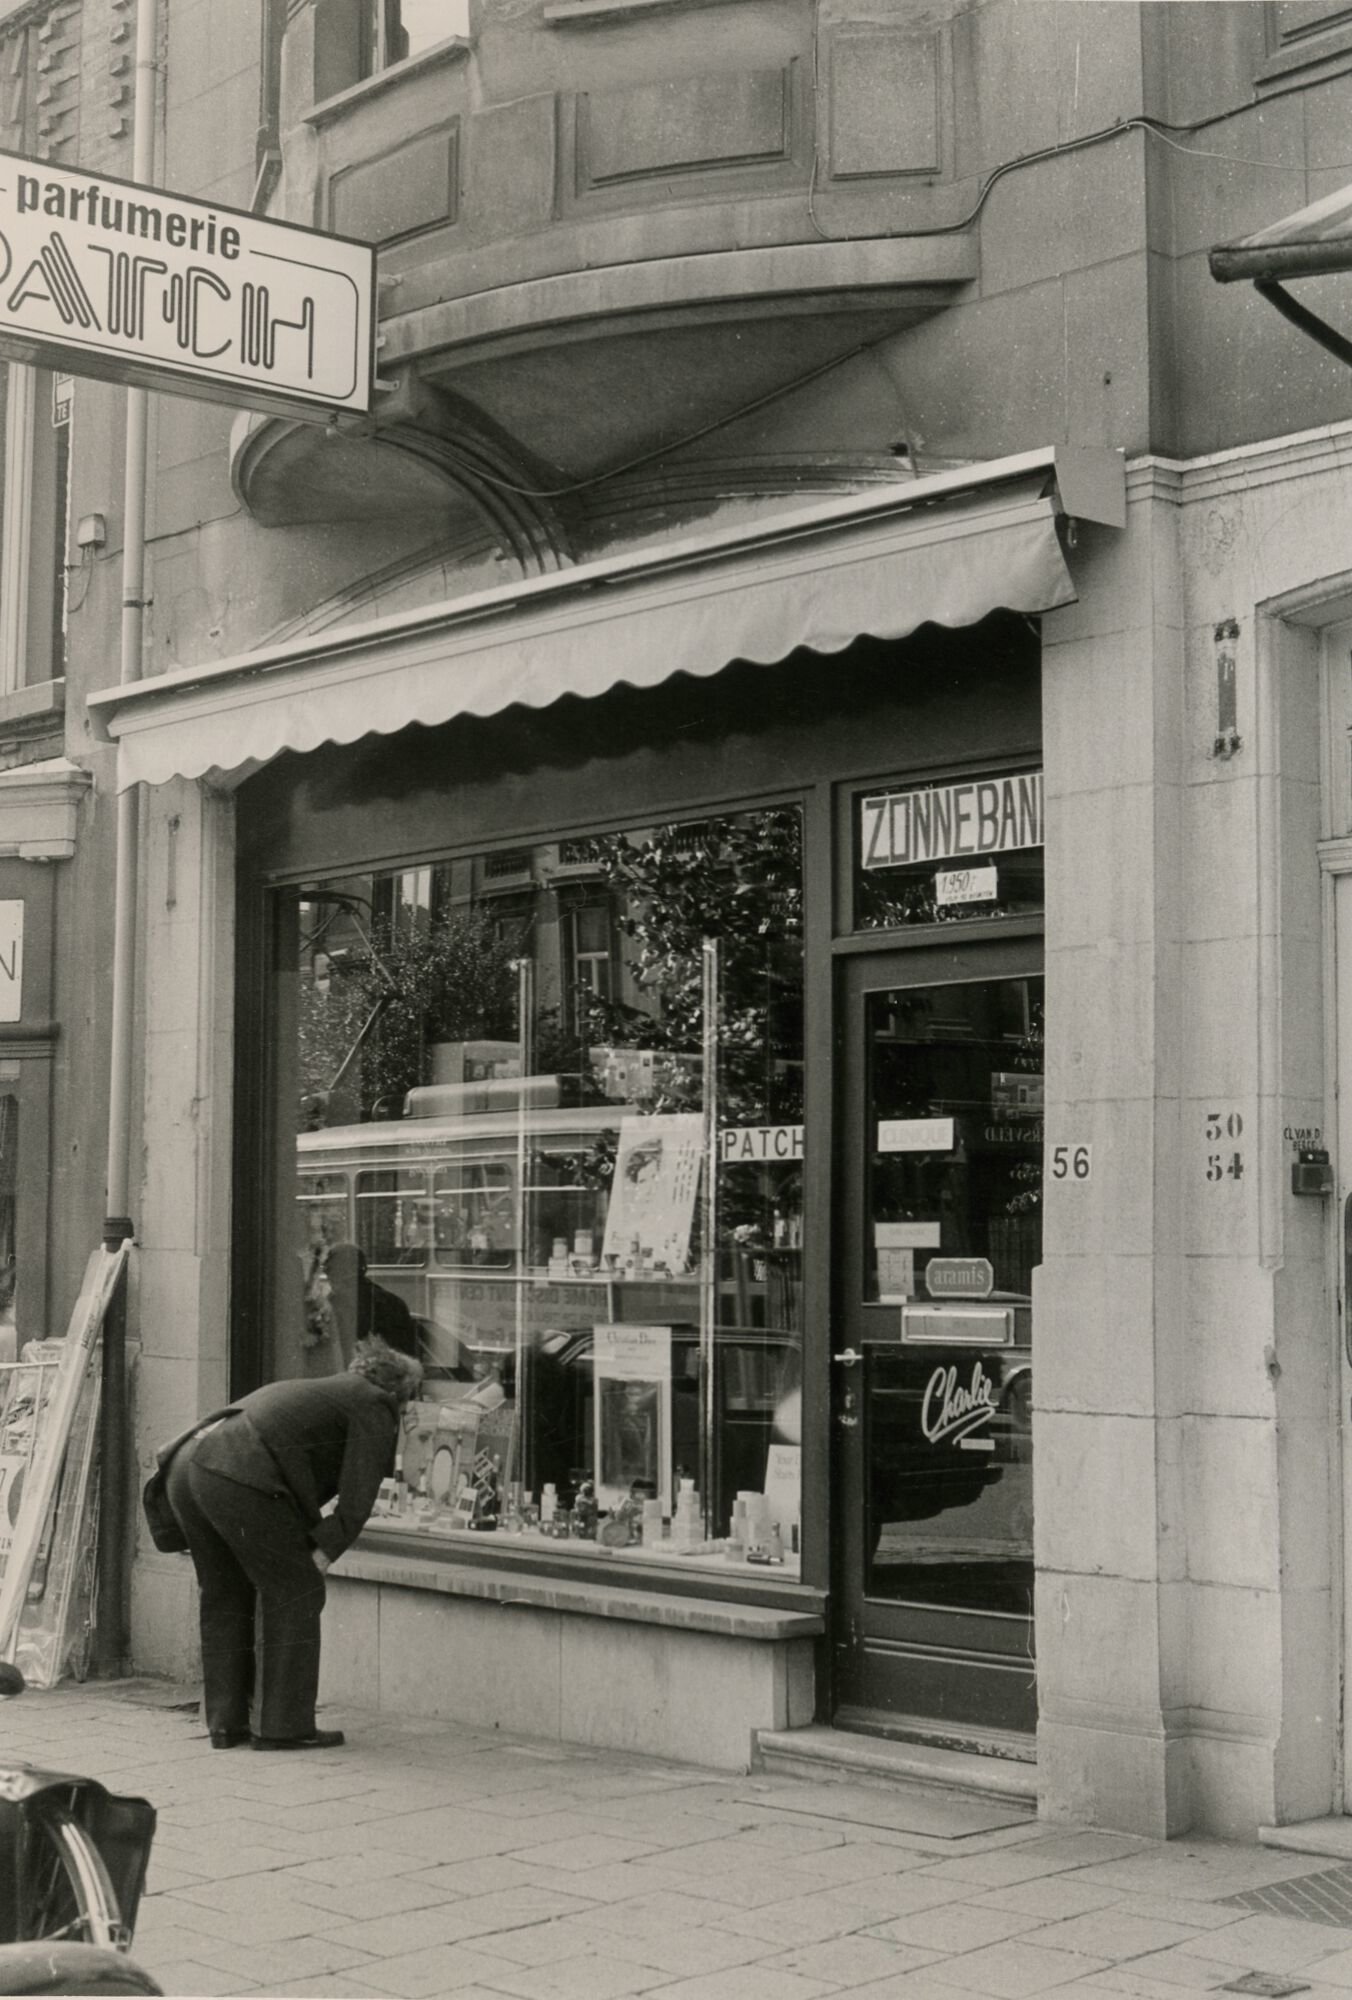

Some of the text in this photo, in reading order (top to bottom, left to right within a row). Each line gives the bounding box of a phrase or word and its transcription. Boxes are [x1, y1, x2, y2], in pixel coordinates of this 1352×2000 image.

[16, 173, 242, 260] parfumerie
[864, 773, 1045, 868] ZONNEBAN
[1205, 1112, 1244, 1141] 50
[1052, 1146, 1090, 1179] 56
[1205, 1152, 1244, 1182] 54
[933, 1266, 985, 1286] aramis
[921, 1361, 1000, 1440] Charlie
